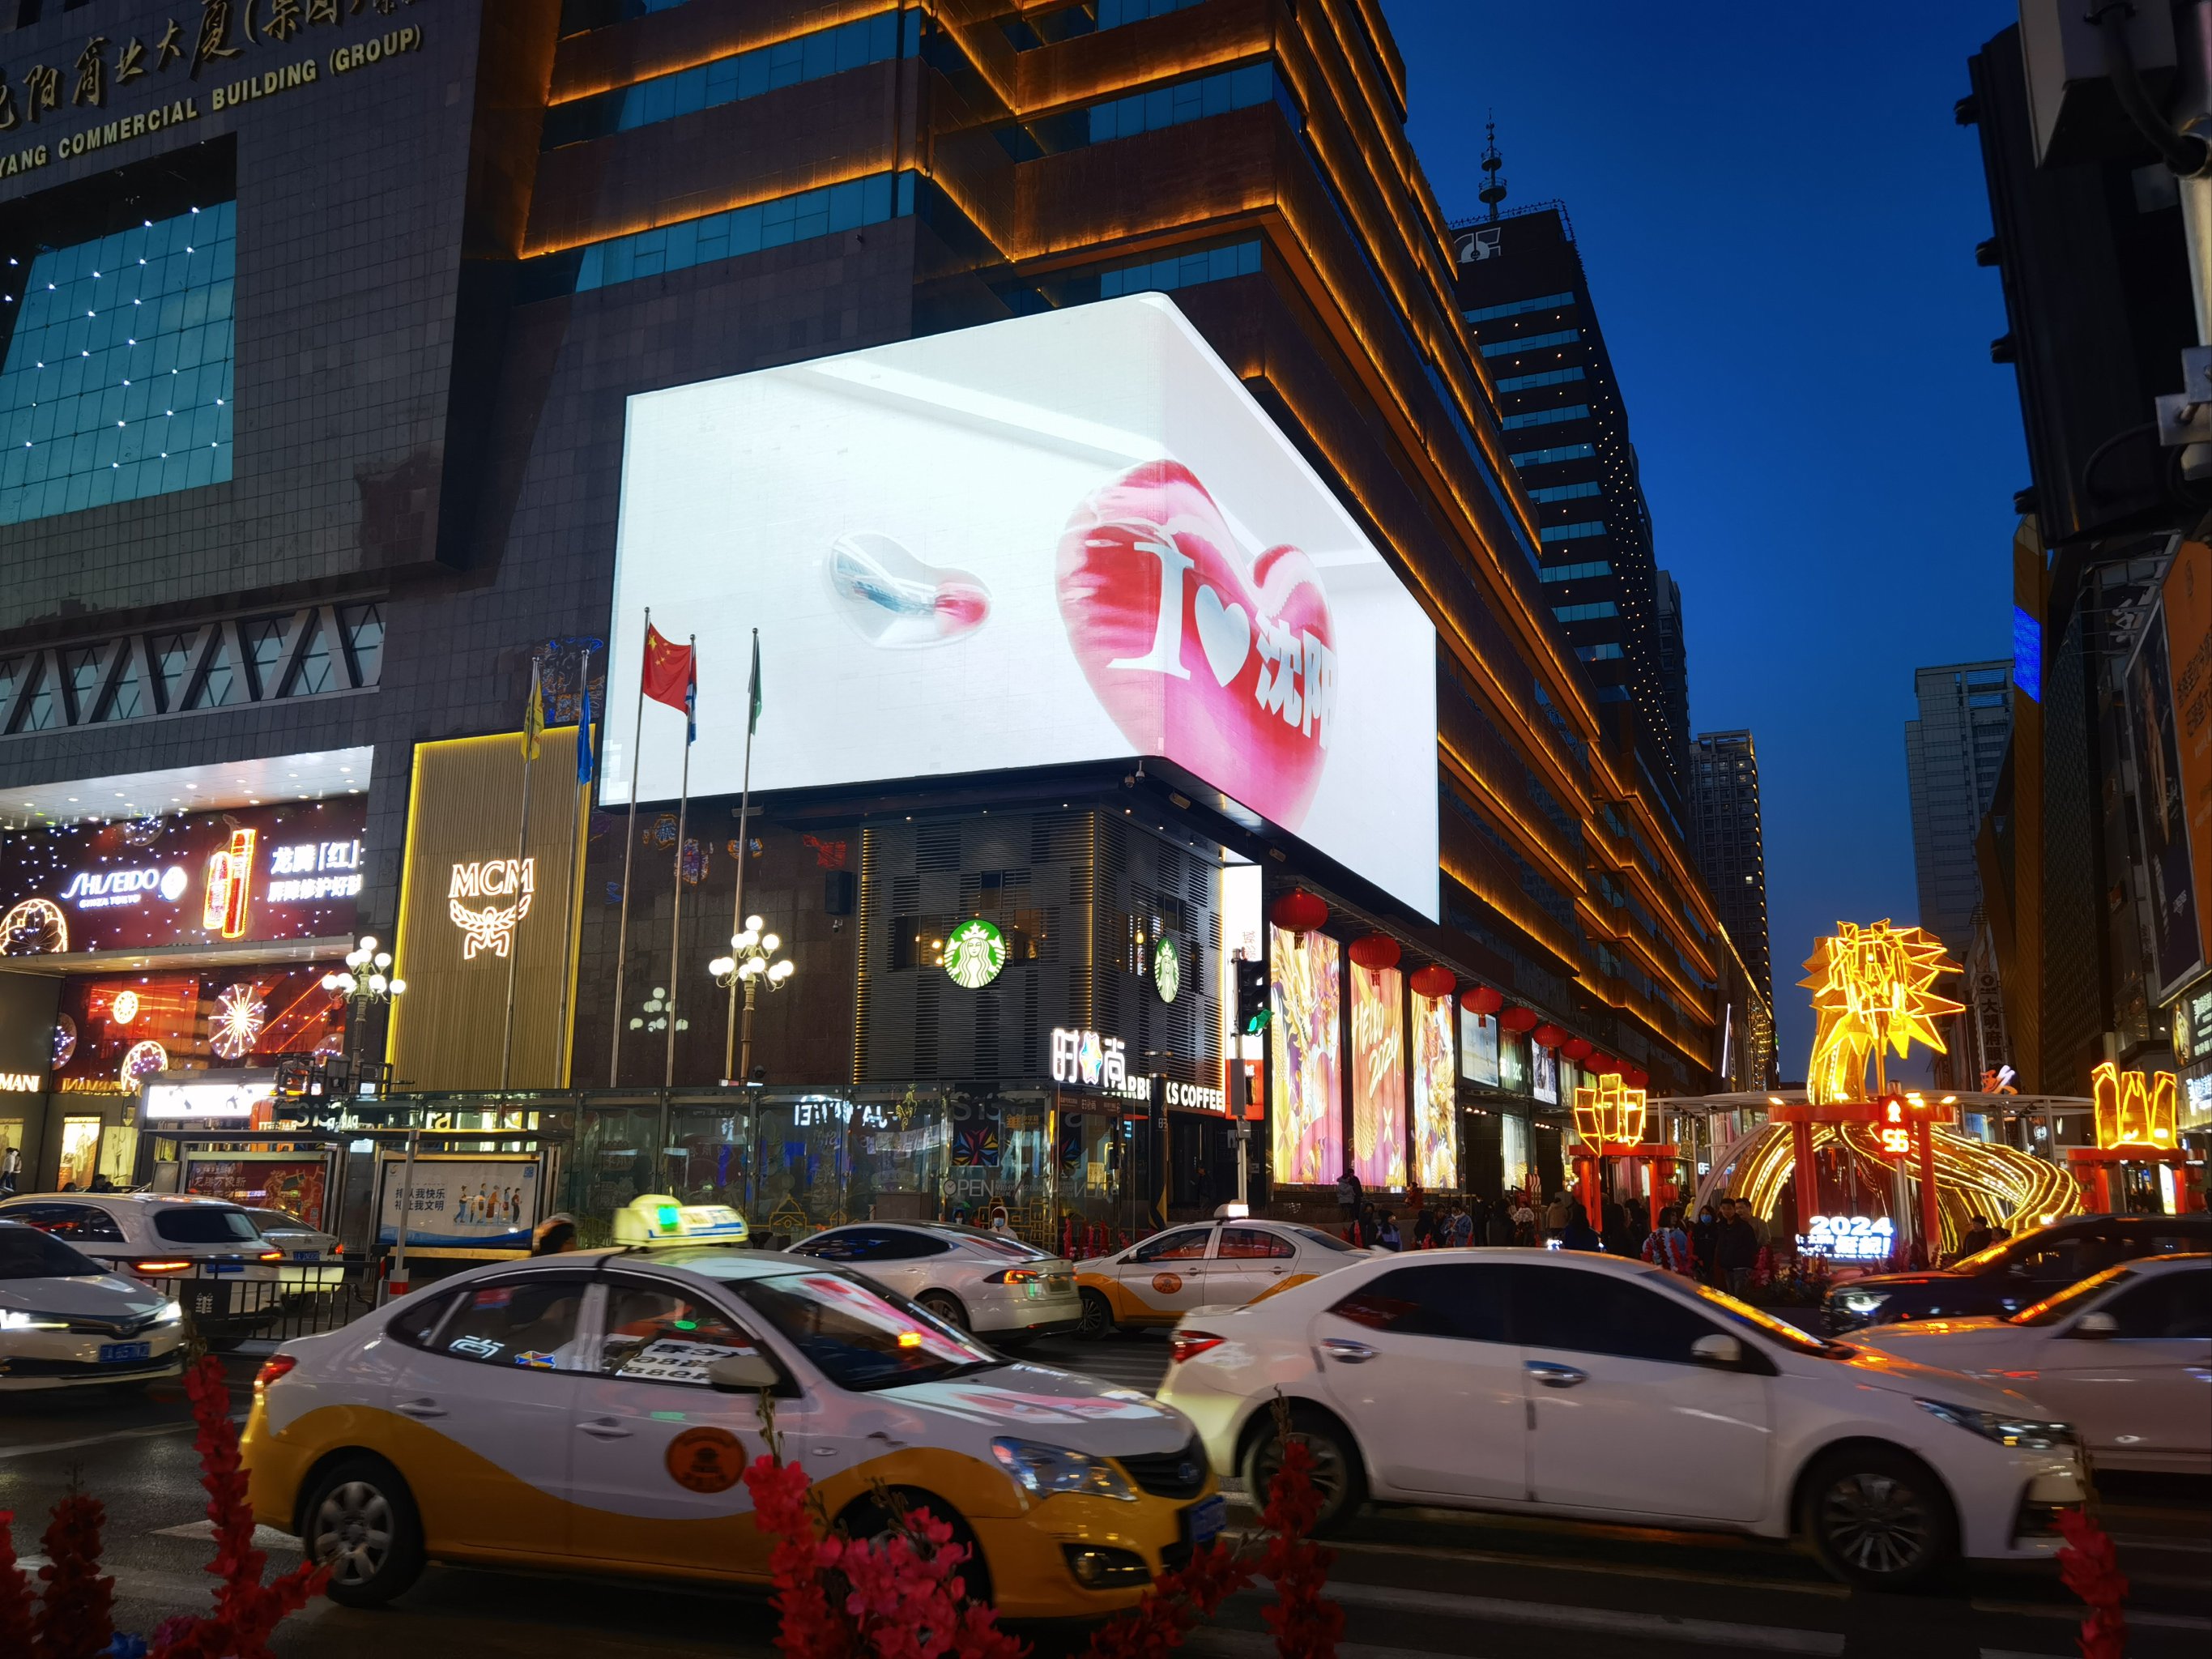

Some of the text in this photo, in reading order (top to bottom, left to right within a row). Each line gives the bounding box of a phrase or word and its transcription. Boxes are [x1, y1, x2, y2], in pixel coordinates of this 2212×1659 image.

[58, 97, 198, 159] COMMERCIAL
[212, 58, 316, 110] BUILDING
[329, 23, 420, 75] (GROUP)
[60, 868, 160, 899] SHISEIDO
[448, 858, 535, 898] MCM
[1181, 1084, 1225, 1113] COFFEE
[1809, 1216, 1894, 1236] 2024
